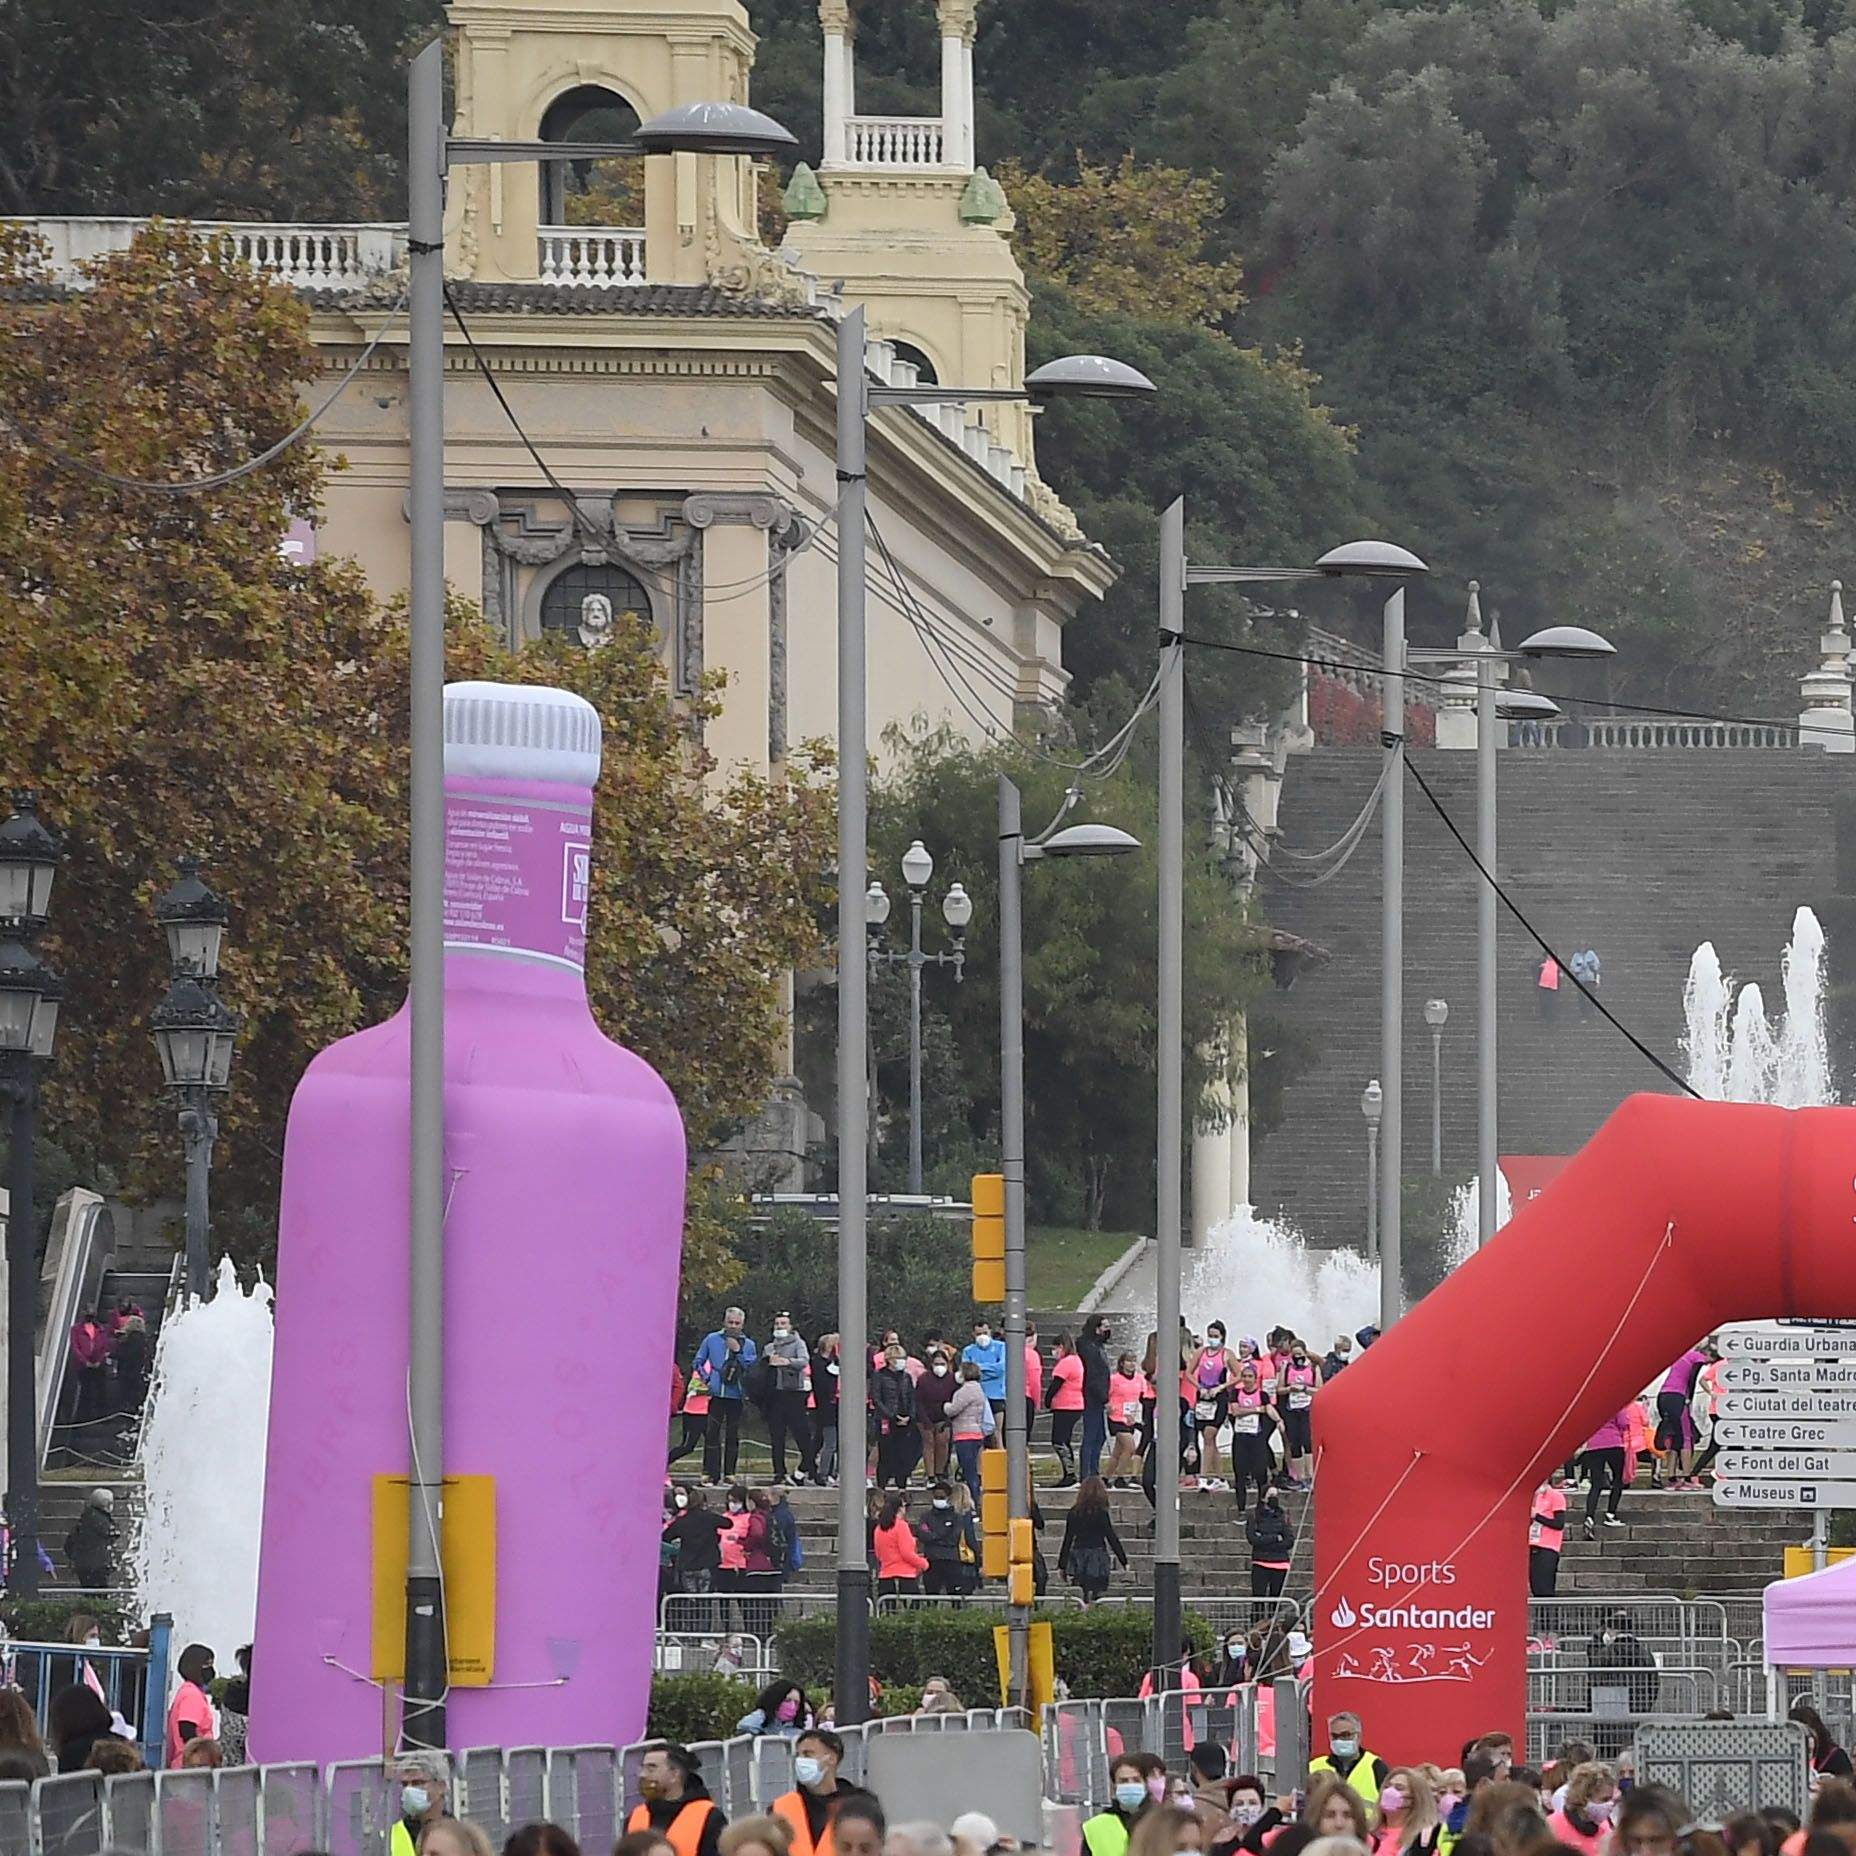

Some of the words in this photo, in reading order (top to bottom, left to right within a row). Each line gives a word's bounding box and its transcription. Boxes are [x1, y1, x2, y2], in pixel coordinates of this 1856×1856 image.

[1743, 1337, 1800, 1352] Guardia
[1742, 1369, 1765, 1384] Pg.
[1770, 1369, 1811, 1382] Santa
[1743, 1398, 1787, 1411] Ciutat
[1791, 1397, 1813, 1411] del
[1740, 1426, 1786, 1440] Teatre
[1791, 1426, 1825, 1440] Grec
[1741, 1457, 1773, 1470] Font
[1779, 1456, 1800, 1470] del
[1804, 1456, 1830, 1470] Gat
[1739, 1485, 1795, 1500] Museus
[1367, 1557, 1456, 1590] Sports
[1359, 1603, 1496, 1629] Santander
